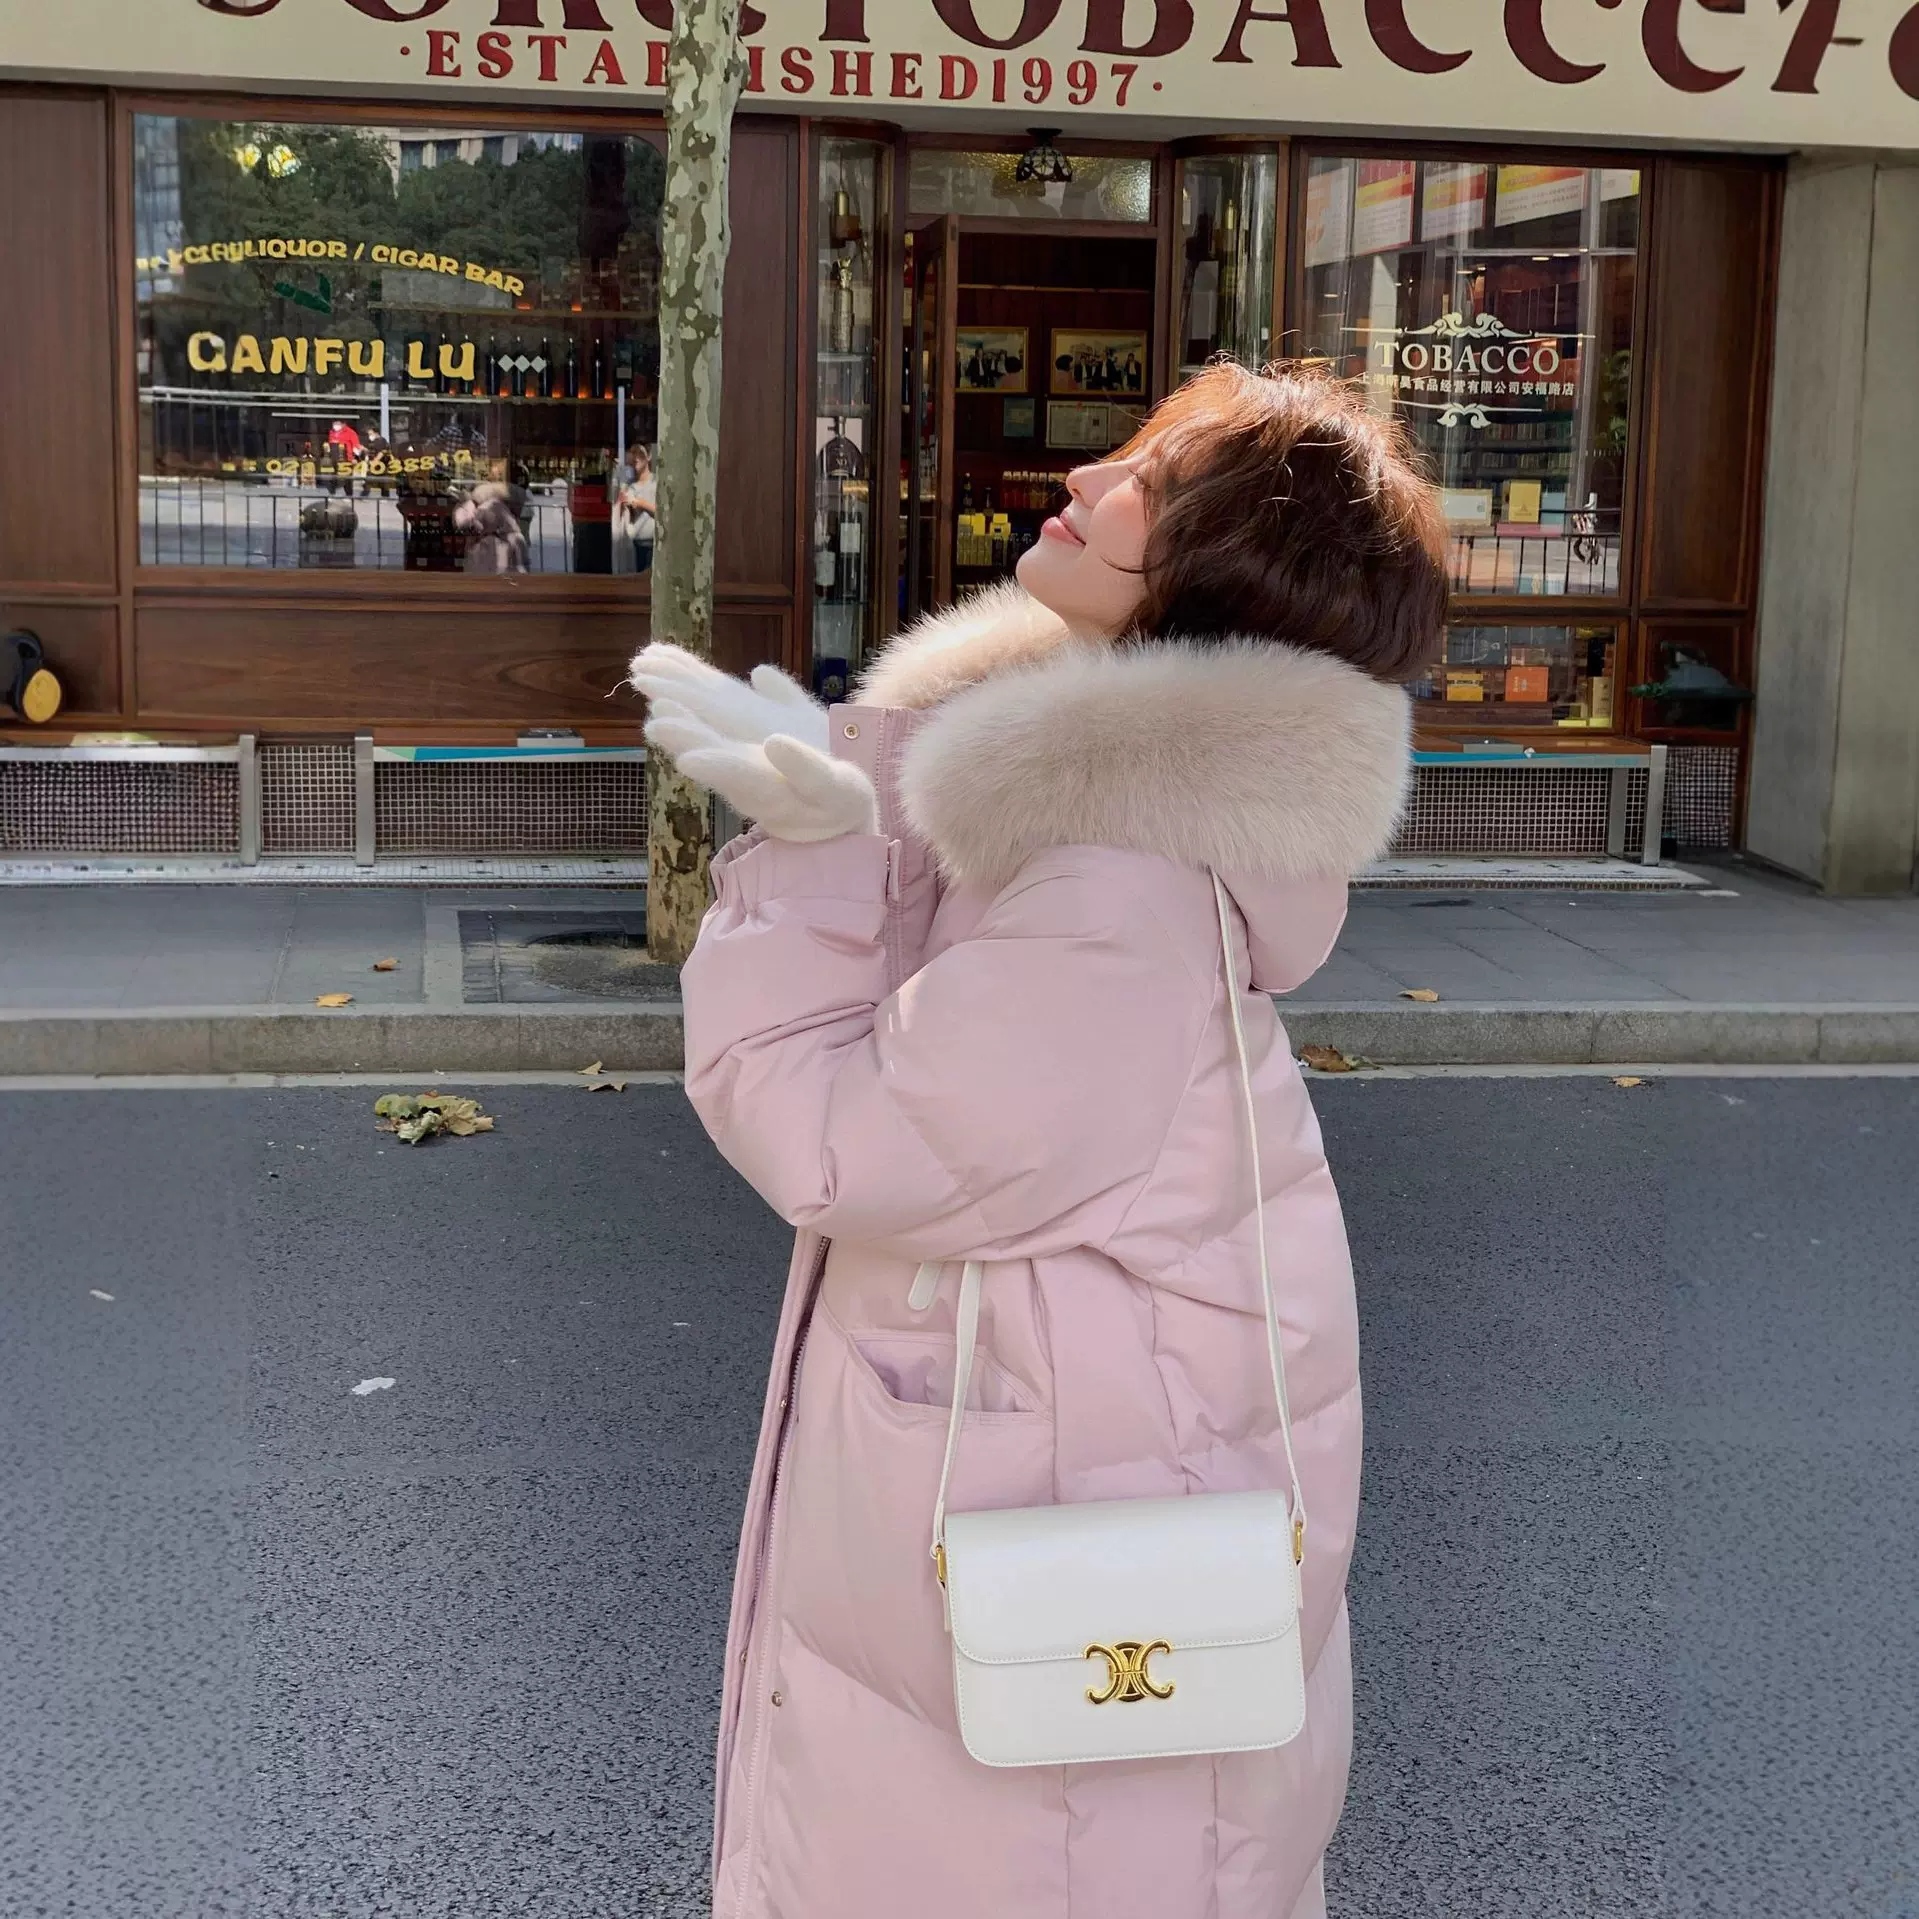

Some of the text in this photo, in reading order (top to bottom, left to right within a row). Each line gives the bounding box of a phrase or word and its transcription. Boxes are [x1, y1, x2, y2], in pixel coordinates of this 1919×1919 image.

[425, 29, 1139, 107] ESTABISHED1997
[244, 239, 347, 259] LIQUOR
[371, 244, 459, 276] CIGAR
[465, 262, 525, 297] BAR
[407, 341, 476, 381] LU
[1373, 340, 1560, 376] TOBACCO
